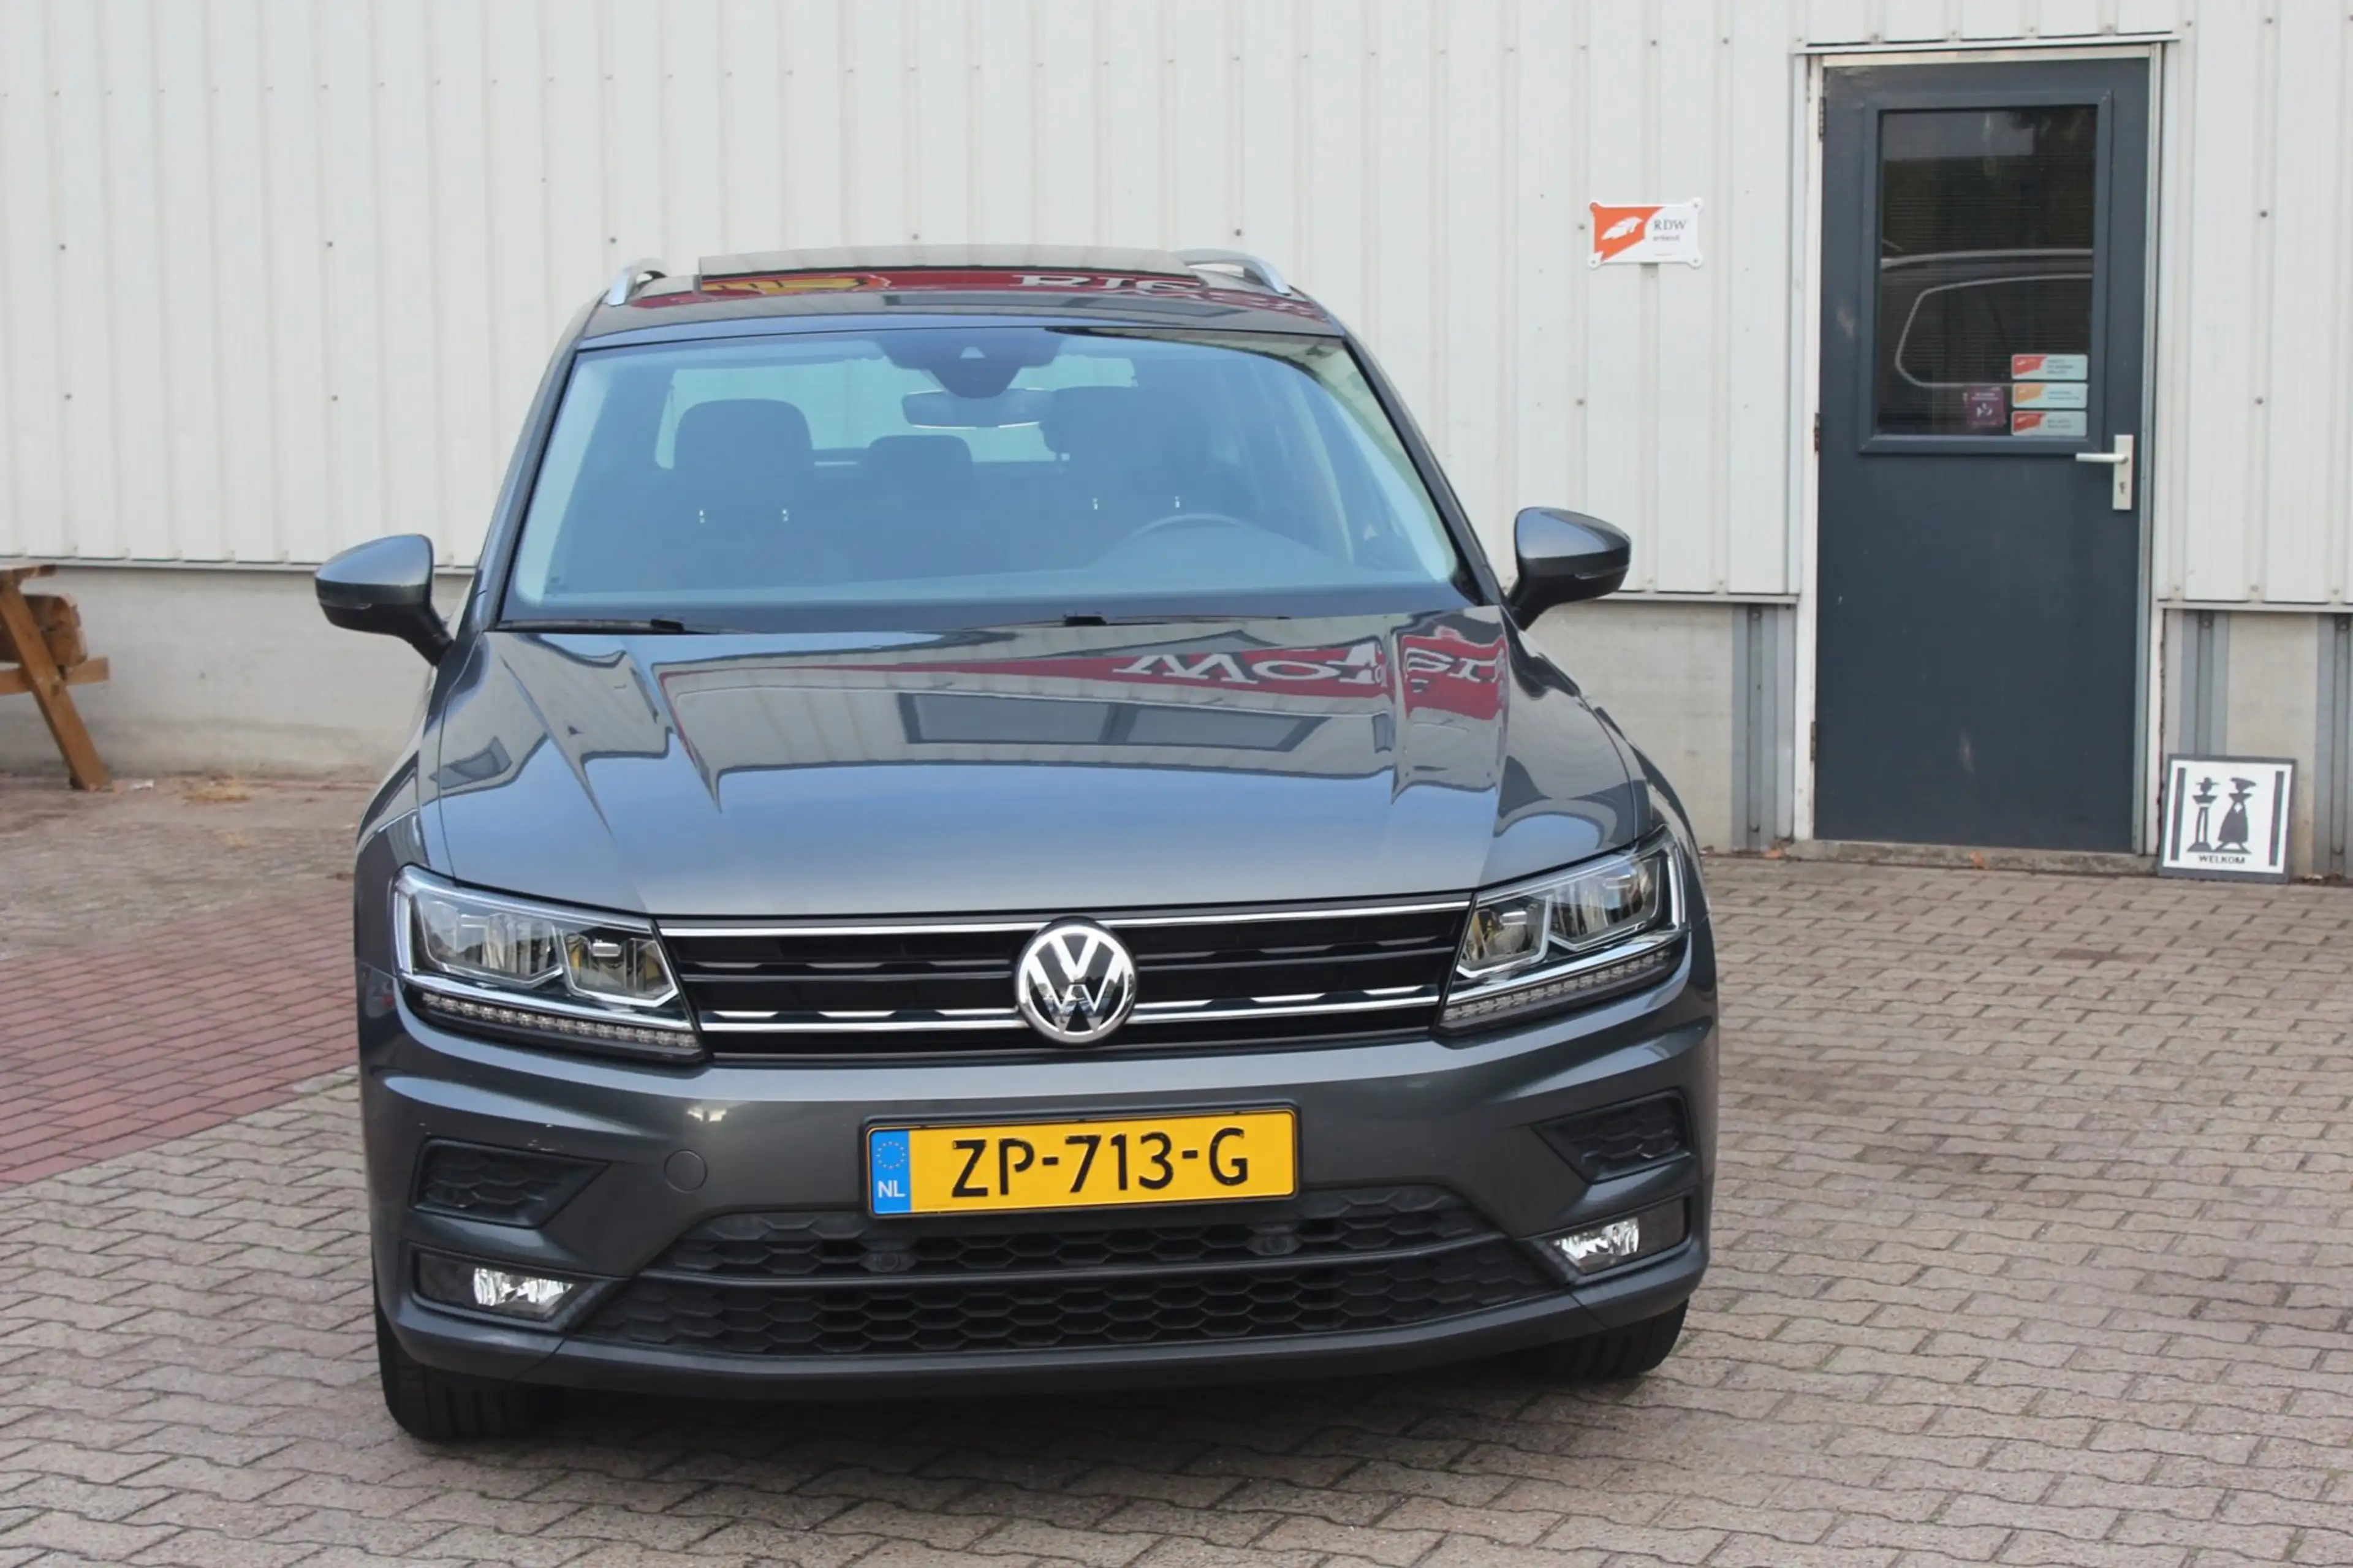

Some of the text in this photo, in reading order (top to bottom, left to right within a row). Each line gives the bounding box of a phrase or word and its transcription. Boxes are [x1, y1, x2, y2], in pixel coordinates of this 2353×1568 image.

[1654, 219, 1687, 230] RDW
[2199, 855, 2245, 863] WELKOM
[951, 1127, 1248, 1198] ZP-713-G
[877, 1180, 905, 1199] NL
